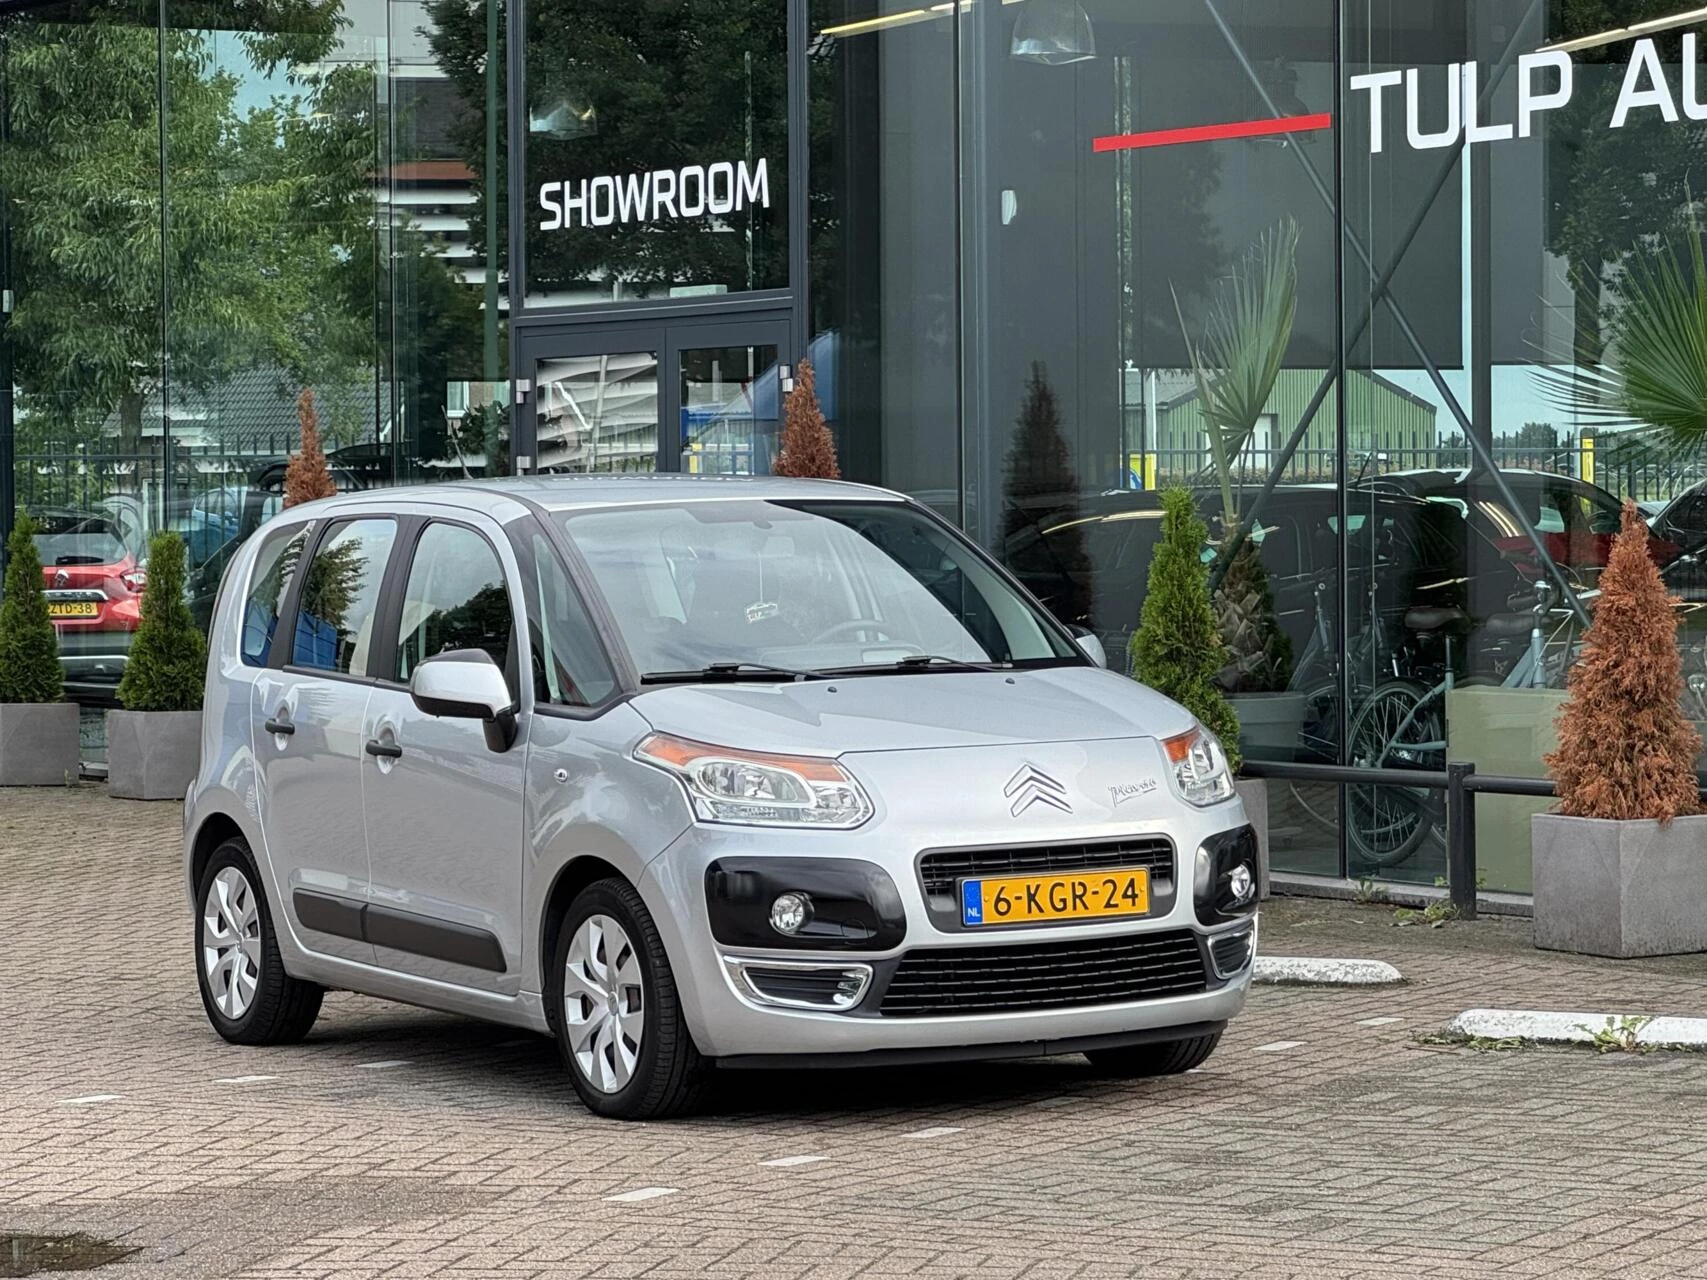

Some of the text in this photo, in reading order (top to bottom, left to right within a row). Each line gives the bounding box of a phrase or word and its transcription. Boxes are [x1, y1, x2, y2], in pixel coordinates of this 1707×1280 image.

[1350, 50, 1573, 153] TULP
[539, 157, 770, 231] SHOWROOM
[967, 907, 981, 918] NL
[993, 877, 1139, 917] 6-KGR-24
